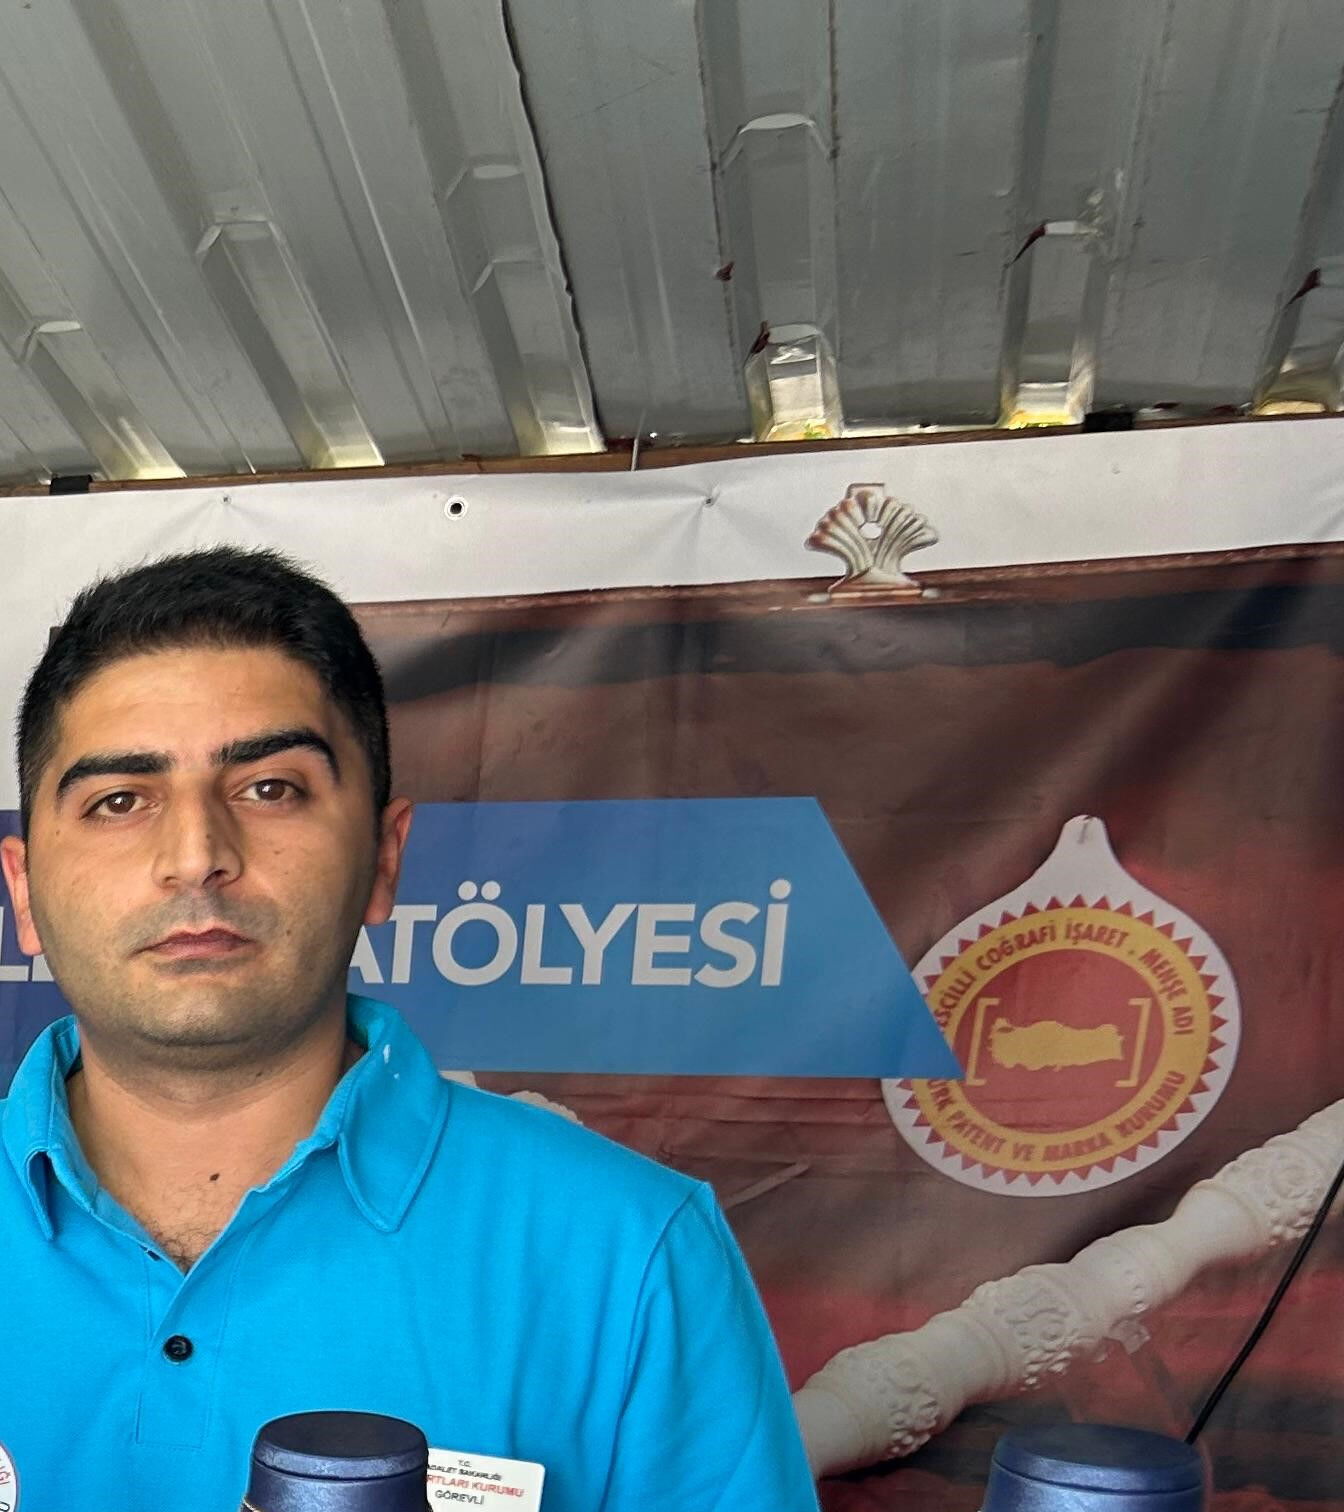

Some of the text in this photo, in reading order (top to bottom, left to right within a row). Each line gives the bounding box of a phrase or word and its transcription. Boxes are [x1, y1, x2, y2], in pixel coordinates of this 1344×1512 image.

[976, 920, 1057, 971] COĞRAFİ
[1065, 918, 1129, 949] İŞARET
[1138, 948, 1187, 1001] MENŞE
[1172, 1006, 1194, 1036] ADI
[946, 1111, 1007, 1154] PATENT
[1013, 1142, 1035, 1161] VE
[1041, 1132, 1113, 1162] MARKA
[1115, 1070, 1186, 1138] KURUMU
